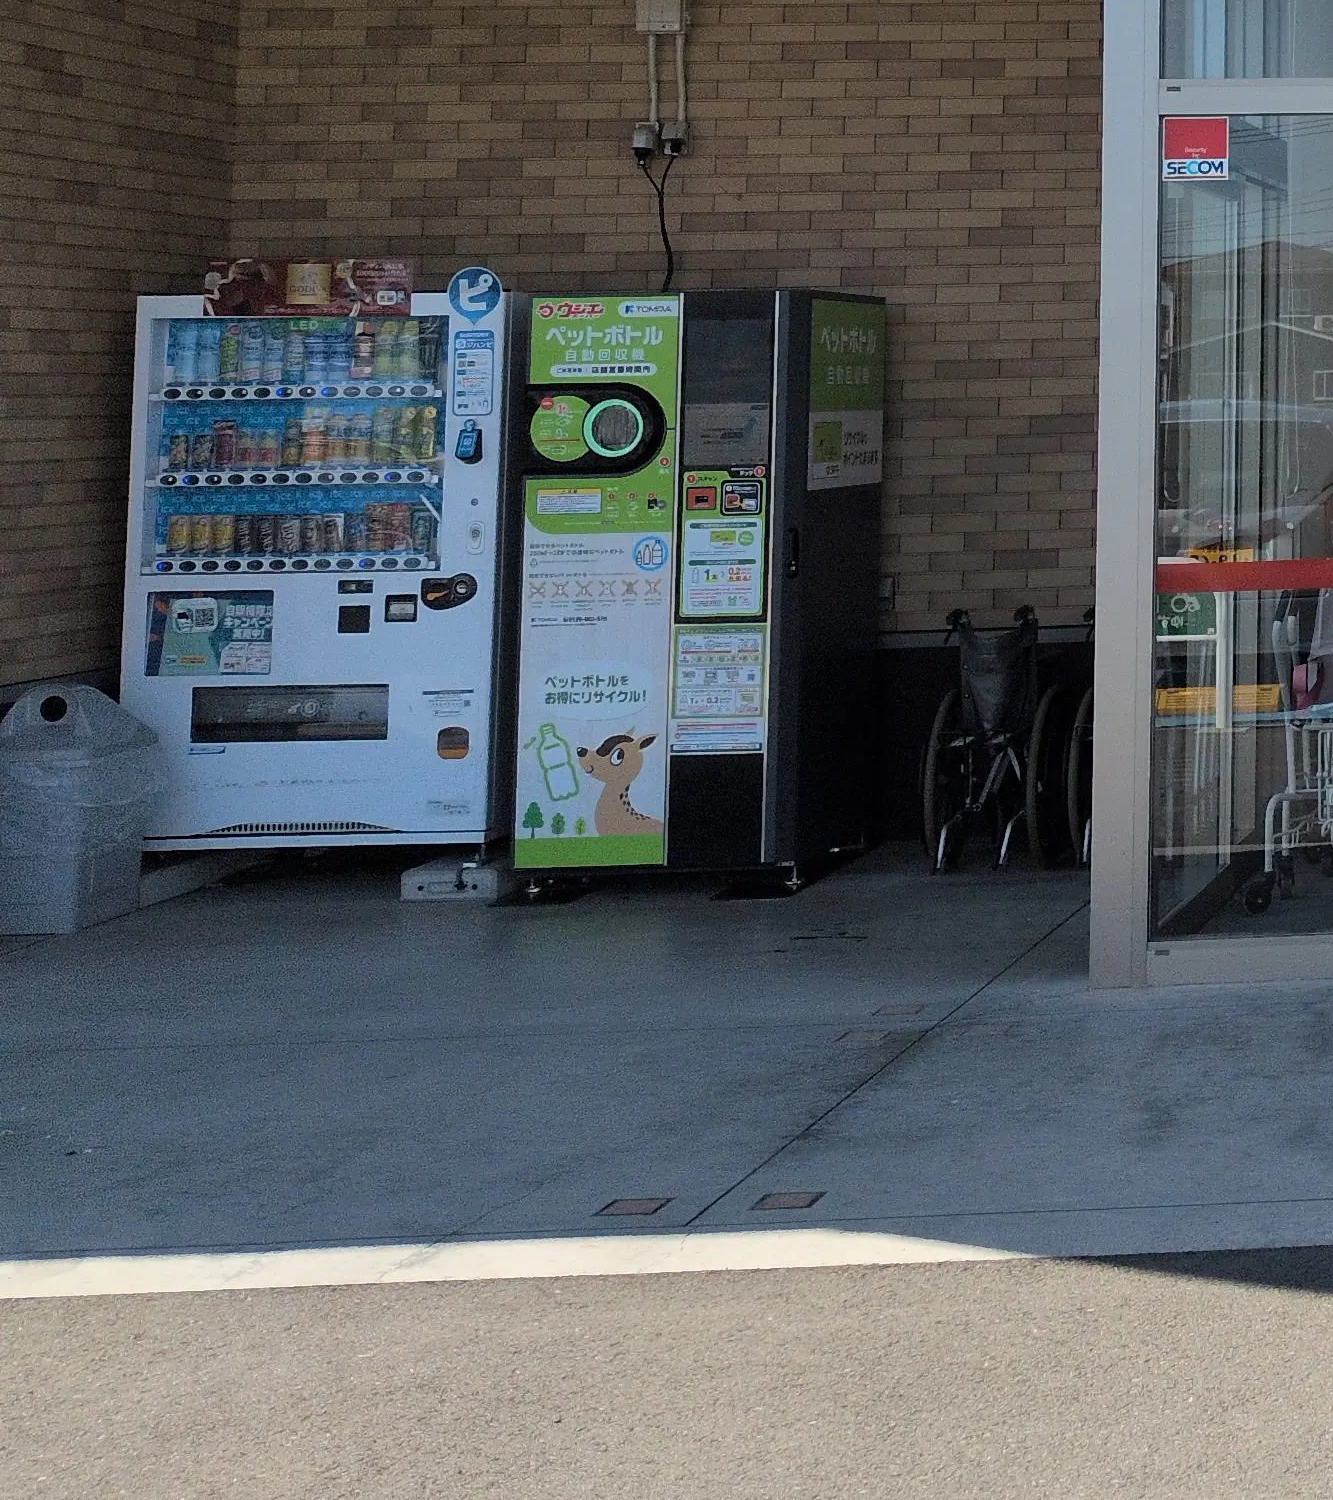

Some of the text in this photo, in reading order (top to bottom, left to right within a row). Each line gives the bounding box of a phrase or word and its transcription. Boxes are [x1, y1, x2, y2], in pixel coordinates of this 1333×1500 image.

[1167, 161, 1223, 174] SECOM
[290, 321, 319, 330] LED
[546, 325, 664, 347] ペットボトル
[820, 326, 878, 355] ペットボトル
[565, 349, 645, 362] 自動回収機
[545, 675, 629, 688] ペットボトルを
[545, 690, 647, 705] お得にリサイクル!
